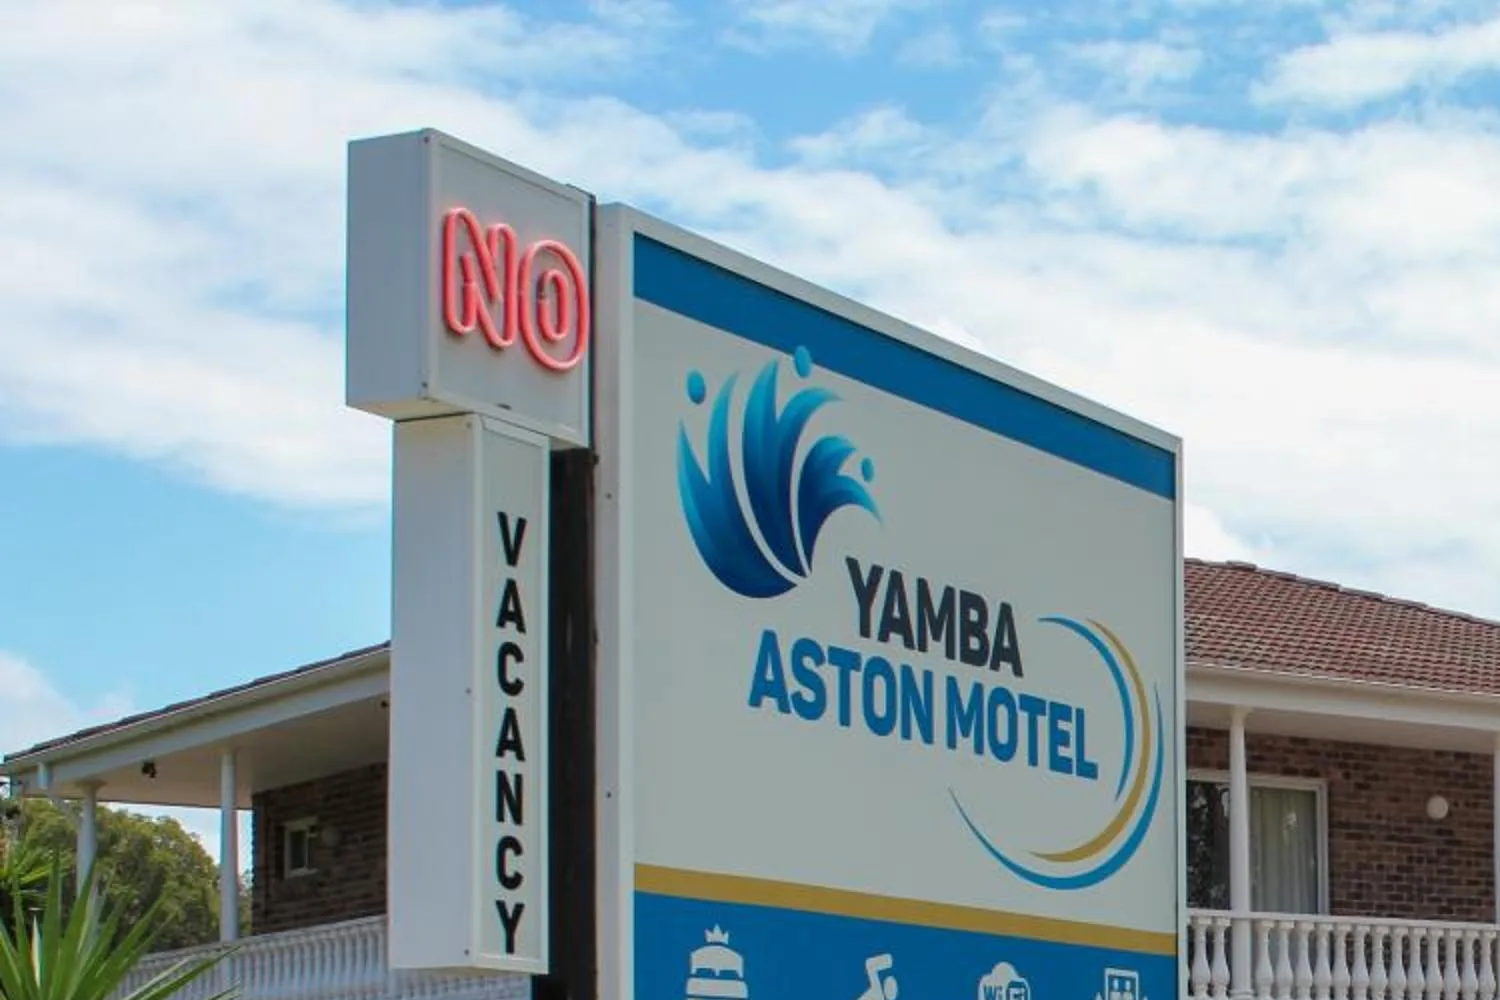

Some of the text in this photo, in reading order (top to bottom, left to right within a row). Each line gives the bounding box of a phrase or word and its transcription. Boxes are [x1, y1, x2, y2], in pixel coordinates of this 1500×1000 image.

[443, 207, 589, 370] NO
[845, 555, 1024, 678] YAMBA
[495, 511, 527, 955] VACANCY
[747, 628, 1099, 781] ASTON MOTEL
